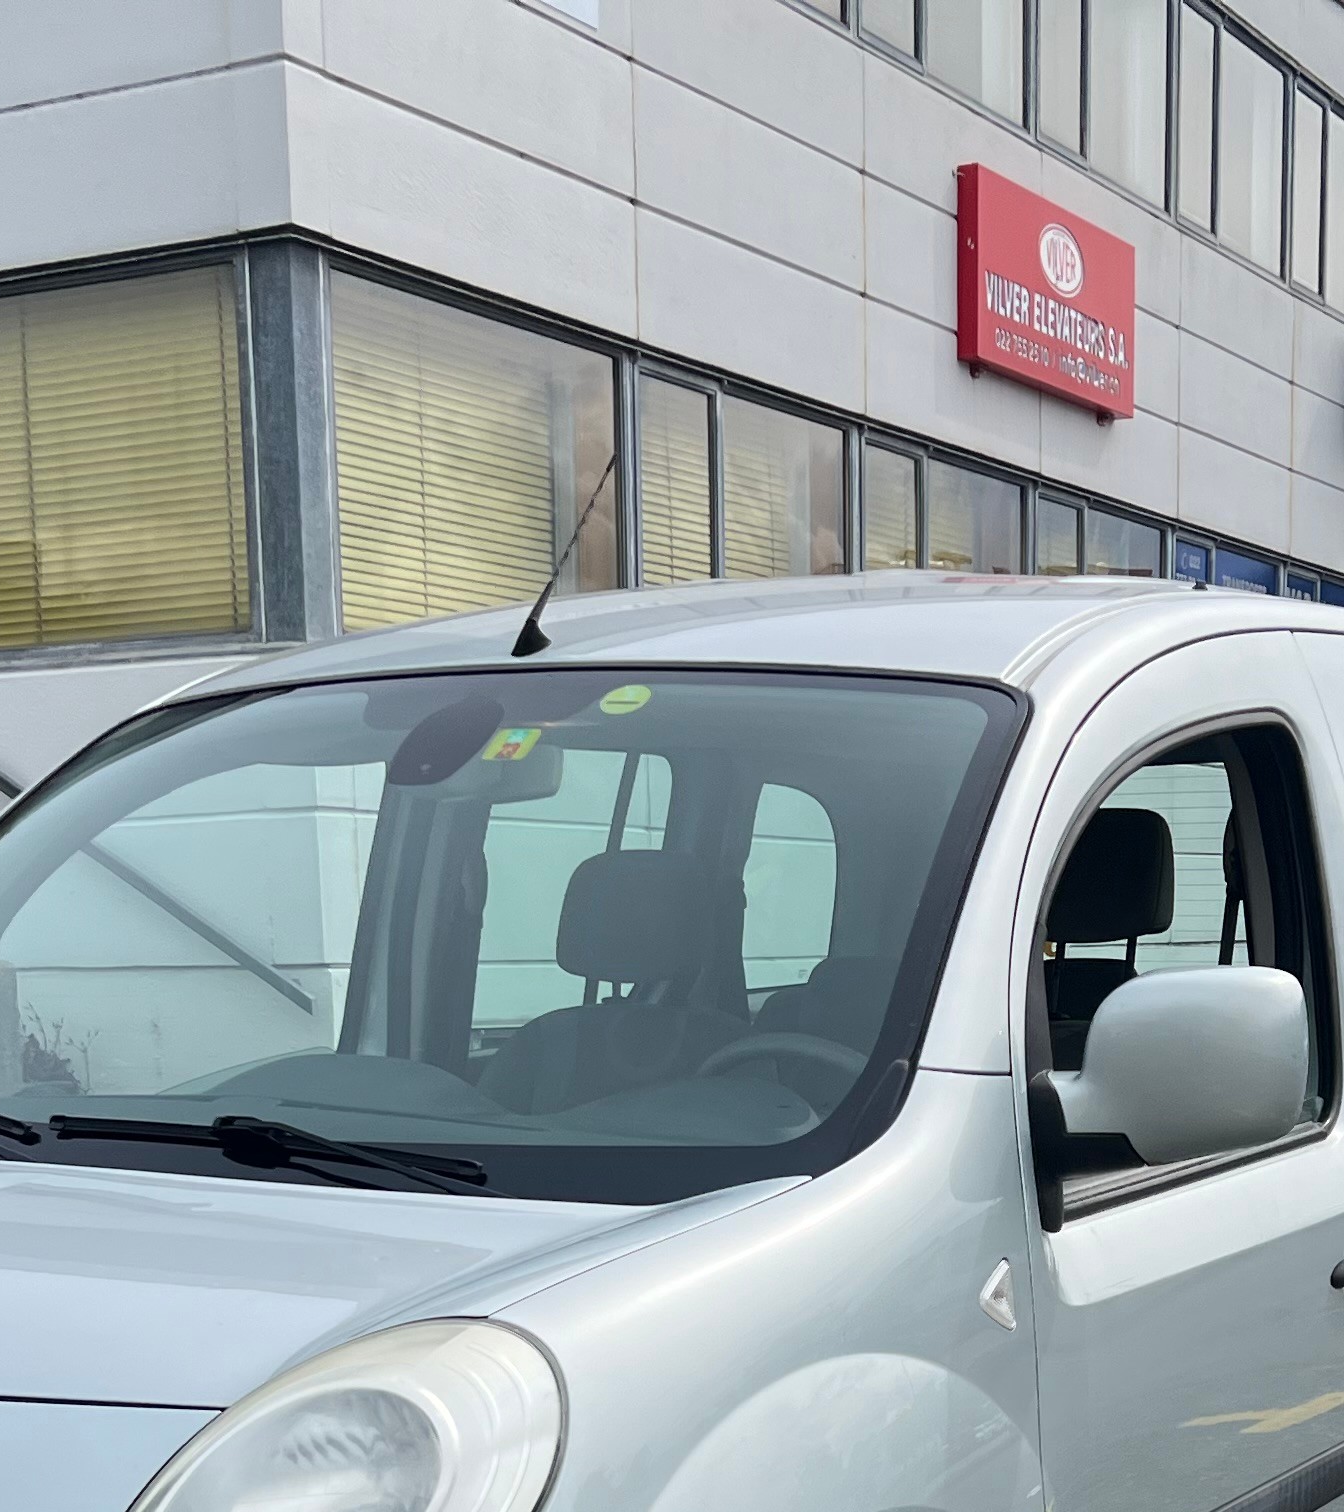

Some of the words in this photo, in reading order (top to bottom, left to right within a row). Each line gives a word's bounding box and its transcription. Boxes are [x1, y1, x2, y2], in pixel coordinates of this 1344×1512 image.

[984, 268, 1030, 327] VILVER
[1033, 291, 1105, 360] ELEVATEURS
[1108, 325, 1129, 370] S.A.
